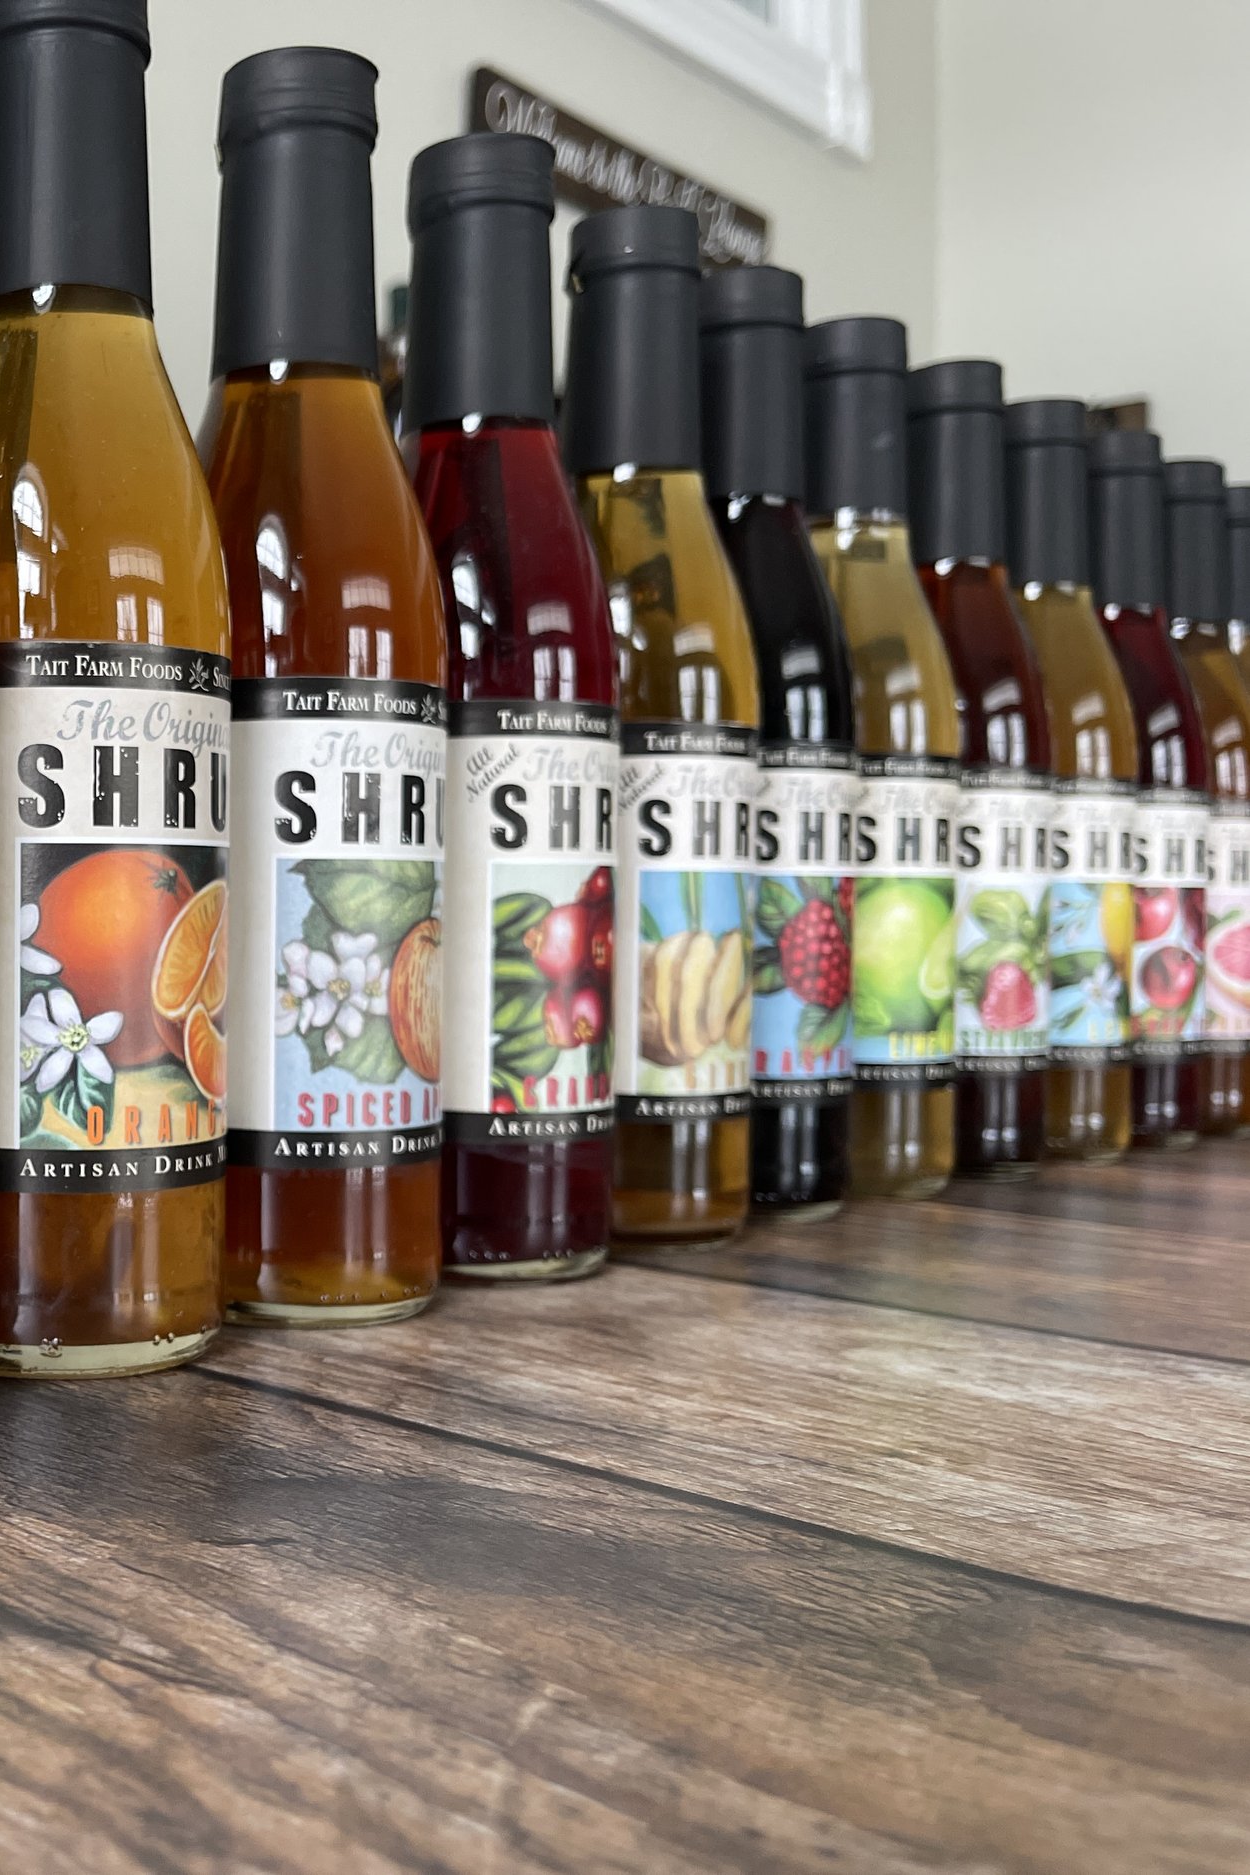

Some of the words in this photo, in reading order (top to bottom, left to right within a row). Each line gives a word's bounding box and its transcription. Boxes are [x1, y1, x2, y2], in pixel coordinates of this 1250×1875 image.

[26, 655, 69, 677] TAIT
[74, 655, 124, 677] FARM
[130, 657, 182, 681] FOODS
[282, 691, 322, 711] TAIT
[327, 691, 370, 712] FARM
[374, 693, 417, 715] FOODS
[56, 699, 138, 741] The
[497, 709, 535, 730] TAIT
[537, 710, 572, 731] FARM
[310, 730, 381, 768] The
[490, 783, 612, 852] SHR
[639, 799, 749, 857] SHR
[297, 1089, 412, 1127] SPICED
[489, 1116, 579, 1136] ARTISAN
[274, 1137, 381, 1157] ARTISAN
[20, 1158, 139, 1177] ARTISAN
[154, 1153, 213, 1175] DRINK
